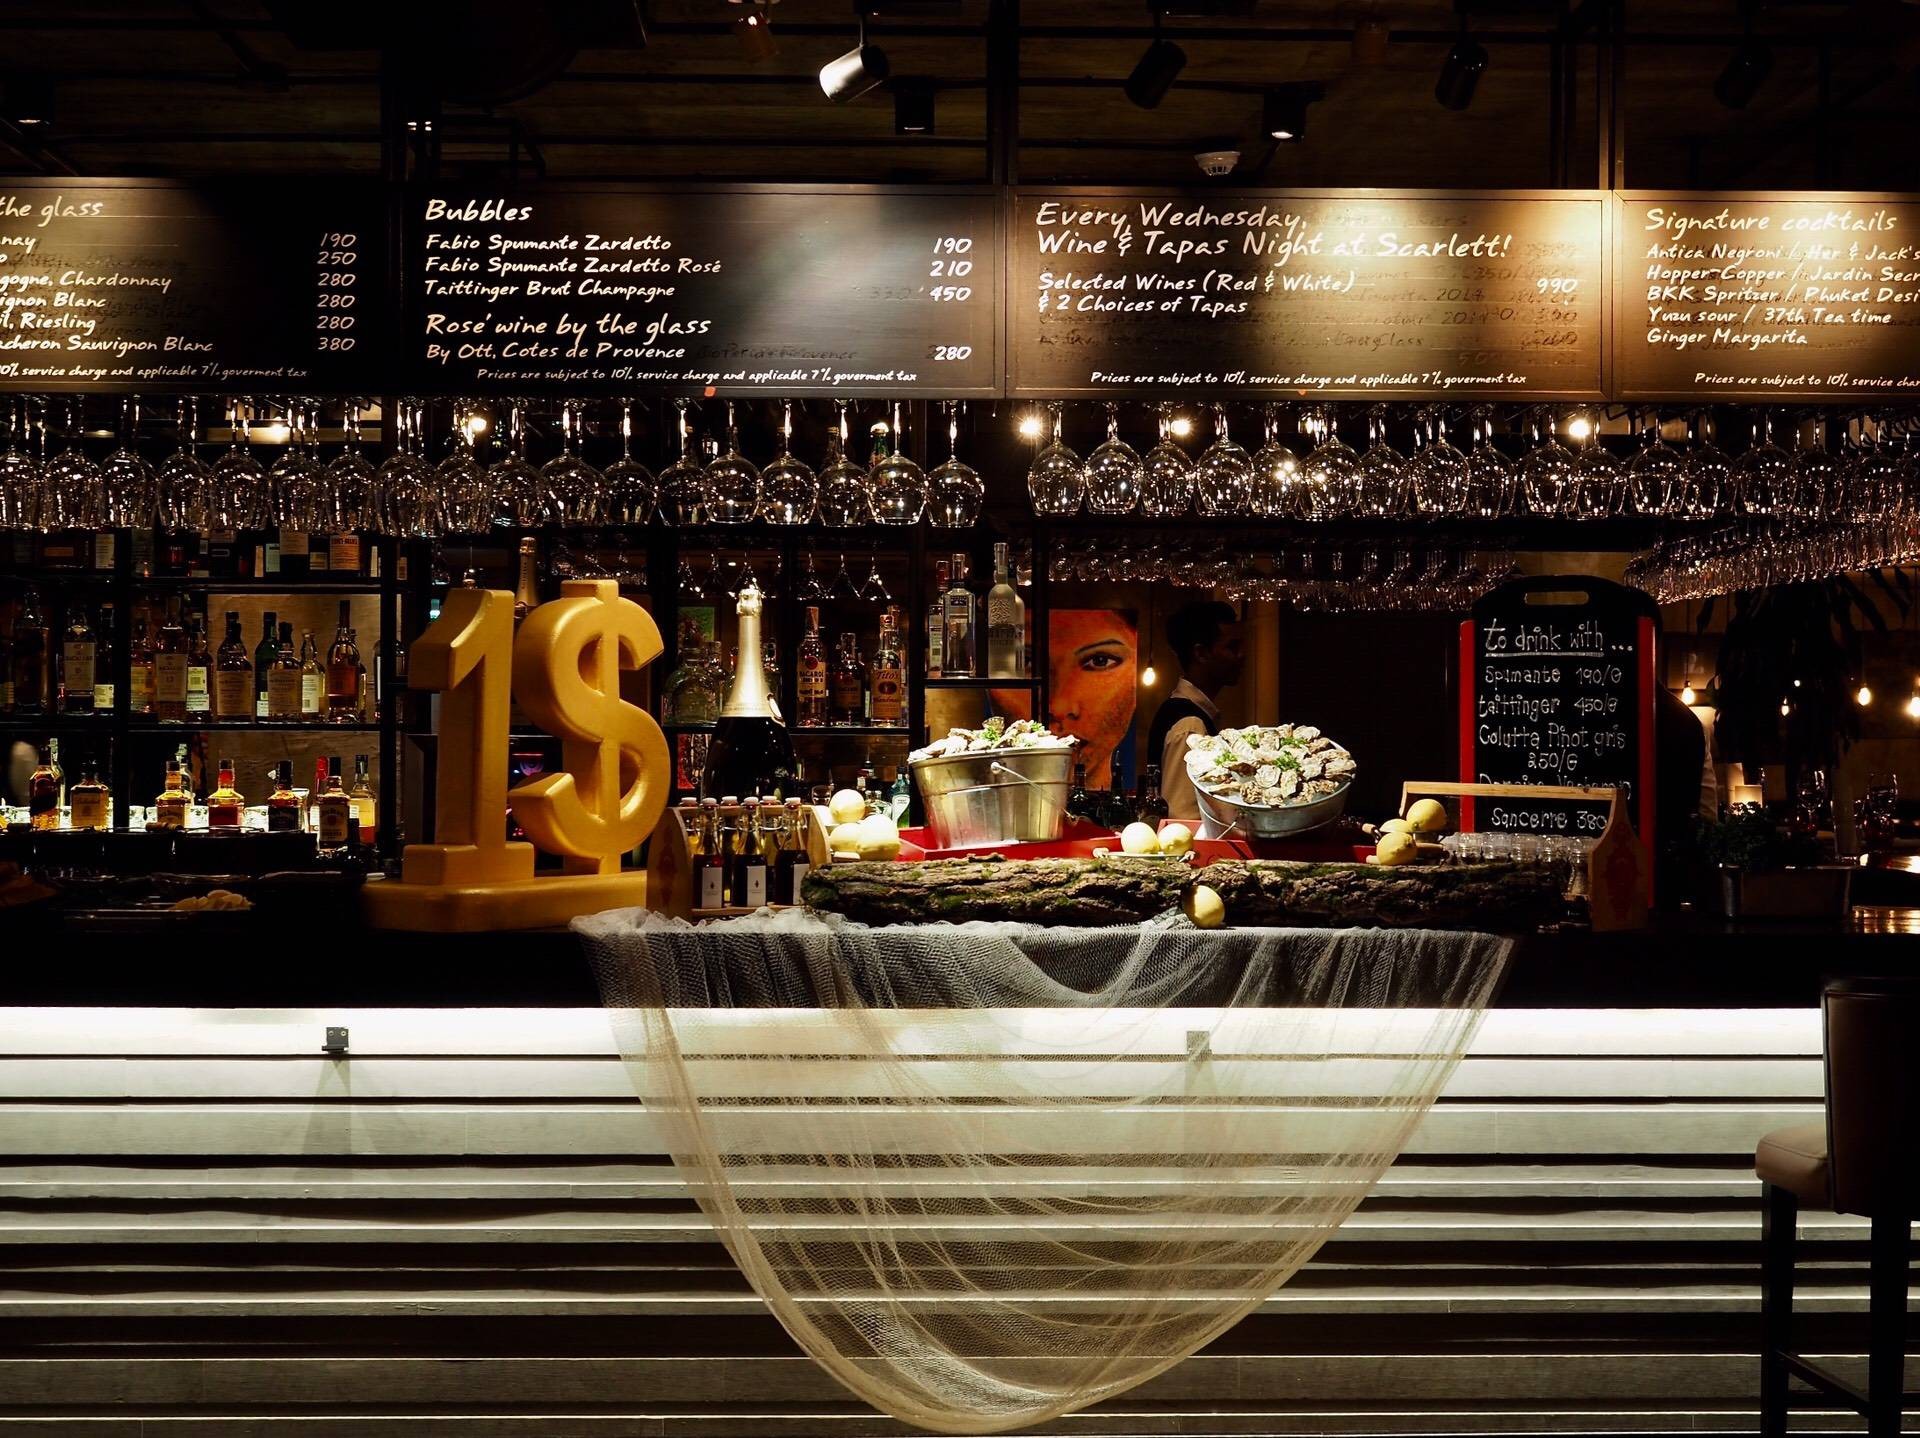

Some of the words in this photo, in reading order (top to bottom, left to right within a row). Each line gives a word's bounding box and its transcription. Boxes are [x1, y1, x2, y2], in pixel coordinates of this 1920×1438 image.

[0, 197, 31, 217] the
[37, 196, 105, 227] glass
[426, 199, 532, 221] Bubbles
[1141, 203, 1305, 241] Wednesday,
[1645, 207, 1770, 241] Signature
[1783, 210, 1897, 231] cocktails
[321, 233, 356, 247] 190
[426, 234, 480, 249] Fabio
[488, 234, 578, 254] Spumante
[584, 235, 671, 250] Zardetto
[934, 238, 972, 254] 190
[1038, 230, 1107, 253] Wine
[1117, 224, 1134, 257] &
[1144, 231, 1228, 263] Tapas
[1242, 230, 1323, 266] Night
[1333, 235, 1363, 256] at
[1378, 233, 1512, 258] Scarlett!
[317, 252, 356, 264] 250
[1648, 244, 1705, 261] Antica
[1711, 244, 1782, 266] Negroni
[1849, 241, 1858, 261] &
[1865, 245, 1920, 260] Jack's
[426, 257, 479, 271] Fabio
[488, 257, 577, 277] Spumante
[584, 257, 670, 272] Zardetto
[678, 258, 721, 273] Rosé
[930, 261, 972, 276] 210
[1811, 267, 1872, 281] Jardin
[57, 271, 171, 296] Chardonnay
[318, 273, 355, 286] 280
[425, 280, 519, 302] Taittinger
[527, 281, 571, 295] Brut
[578, 279, 675, 302] Champagne
[929, 286, 971, 301] 450
[1039, 273, 1126, 291] Selected
[1136, 274, 1196, 290] Wines
[1203, 270, 1257, 292] (Red
[1264, 270, 1275, 292] &
[1283, 272, 1354, 292] White)
[1537, 277, 1577, 295] 990
[53, 292, 106, 307] Blanc
[317, 294, 355, 307] 280
[1038, 291, 1050, 313] &
[1057, 294, 1071, 310] 2
[1077, 295, 1155, 312] Choices
[1161, 297, 1183, 312] of
[1190, 296, 1247, 318] Tapas
[1648, 285, 1696, 301] BKK
[1703, 285, 1778, 308] Spritzer
[1804, 287, 1869, 304] Phuket
[20, 312, 96, 336] Riesling
[317, 316, 354, 329] 280
[1649, 305, 1691, 322] Yuzu
[1698, 311, 1737, 322] sour
[1742, 304, 1755, 323] /
[1764, 305, 1806, 325] 37th
[1813, 308, 1845, 323] Tea
[1851, 309, 1891, 323] time
[495, 316, 547, 333] wine
[556, 313, 587, 348] by
[596, 313, 637, 334] the
[643, 313, 711, 345] glass
[1647, 328, 1707, 350] Ginger
[1713, 328, 1807, 350] Margarita
[67, 335, 157, 357] Sauvignon
[164, 337, 213, 351] Blanc
[318, 337, 355, 350] 380
[427, 344, 450, 364] By
[503, 342, 558, 357] Cotes
[565, 343, 588, 358] de
[596, 343, 685, 358] Provence
[935, 346, 971, 360] 280
[22, 365, 65, 376] service
[69, 365, 107, 380] charge
[111, 366, 133, 376] and
[137, 366, 197, 378] applicable
[221, 368, 283, 380] goverment
[287, 367, 306, 377] tax
[477, 369, 517, 379] Prices
[545, 369, 588, 381] subject
[592, 369, 605, 379] to
[637, 369, 678, 380] service
[682, 370, 720, 384] charge
[723, 370, 745, 380] and
[749, 370, 807, 383] applicable
[832, 370, 894, 385] goverment
[896, 370, 917, 382] tax
[1091, 372, 1130, 382] Prices
[1134, 375, 1154, 383] are
[1158, 373, 1201, 385] subject
[1205, 372, 1218, 383] to
[1249, 373, 1290, 385] service
[1294, 374, 1331, 388] charge
[1334, 374, 1356, 385] and
[1360, 374, 1418, 387] applicable
[1443, 374, 1503, 388] goverment
[1506, 372, 1526, 384] tax
[1695, 373, 1734, 383] Prices
[1738, 377, 1757, 385] are
[1761, 375, 1804, 387] subject
[1808, 374, 1821, 385] to
[1852, 376, 1893, 387] service
[1484, 618, 1506, 650] to
[1515, 625, 1561, 651] drink
[1491, 808, 1567, 829] Sancerre
